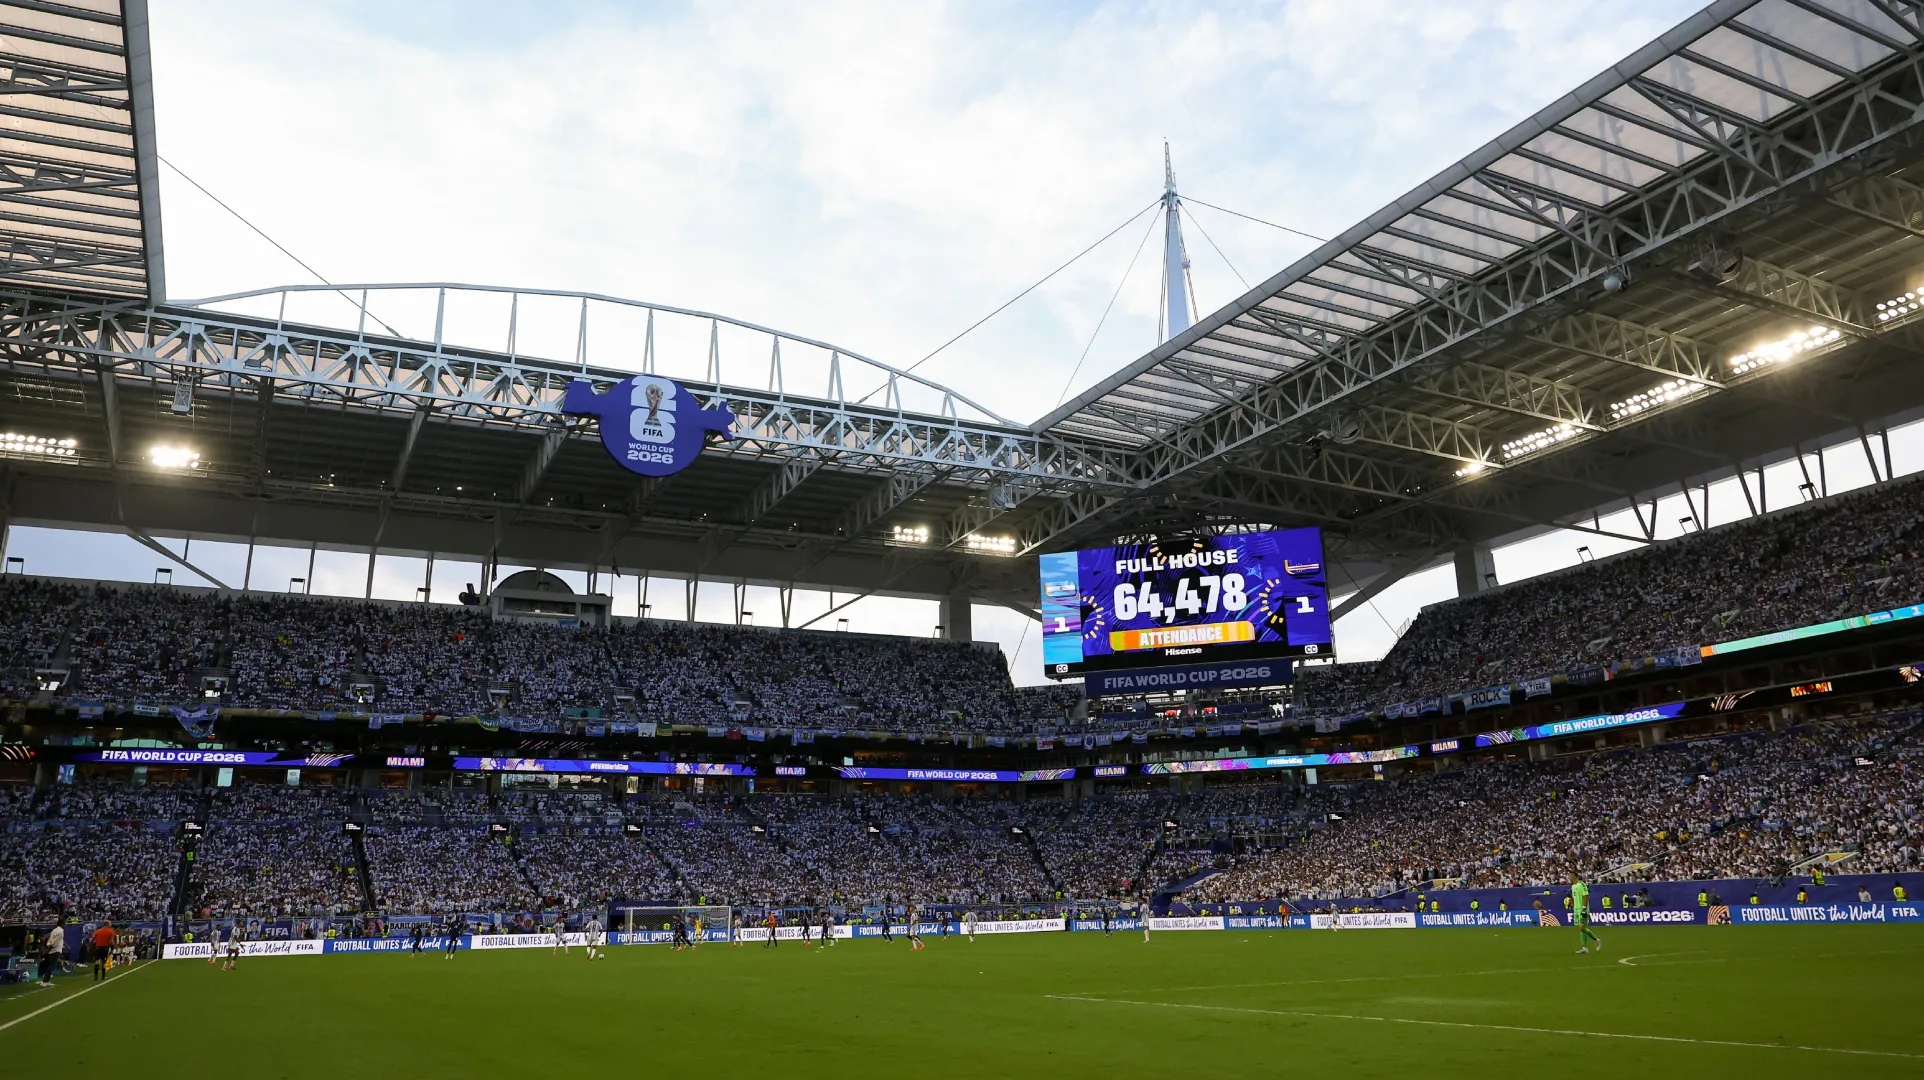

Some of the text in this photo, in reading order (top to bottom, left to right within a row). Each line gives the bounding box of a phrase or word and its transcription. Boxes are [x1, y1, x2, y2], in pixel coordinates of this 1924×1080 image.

[642, 428, 663, 437] FIFA
[628, 442, 657, 451] WORLD
[627, 450, 673, 464] 2026
[1115, 549, 1238, 574] FULL HOUSE
[1113, 573, 1247, 624] 64,478
[1296, 596, 1315, 613] 1
[1054, 617, 1070, 632] 1
[1140, 626, 1223, 646] ATTENDANCE
[1165, 647, 1202, 656] Hisense
[1104, 666, 1271, 689] FIFA WORLD CUP 2026
[1791, 682, 1832, 697] MIAMI
[1472, 690, 1501, 705] ROCK
[1553, 709, 1659, 733] FIFA WORLD CUP 2026
[1432, 740, 1458, 752] MIAMI
[102, 750, 244, 763] FIFA WORLD CUP 2026
[386, 757, 424, 767] MIAMI
[775, 767, 806, 776] MIAMI
[926, 771, 953, 779] WORLD
[954, 772, 970, 780] CUP
[970, 772, 998, 780] 2026
[1095, 767, 1125, 776] MIAMI
[1422, 912, 1532, 926] FOOTBALL UNITES the World FIFA
[1589, 911, 1691, 922] WORLD CUP 2026
[1741, 905, 1919, 922] FOOTBALL UNITES the World FIFA
[994, 922, 1014, 932] UNITES
[1015, 919, 1028, 931] the
[1027, 918, 1043, 930] World
[1076, 921, 1101, 929] FOOTBALL
[1153, 919, 1172, 928] FOOTBALL
[1173, 918, 1186, 928] UNITES
[1229, 918, 1250, 928] FOOTBALL
[1250, 917, 1265, 927] UNITES
[1343, 916, 1360, 926] UNITES
[1362, 914, 1374, 925] the
[1374, 914, 1392, 926] World
[265, 928, 289, 937] FIFA
[651, 932, 674, 942] UNITES
[333, 940, 371, 951] FOOTBALL
[373, 939, 399, 949] UNITES
[401, 938, 415, 950] the
[481, 937, 516, 947] FOOTBALL
[518, 936, 542, 946] UNITES
[174, 945, 212, 956] FOOTBAL
[248, 942, 264, 953] the
[264, 941, 291, 953] World
